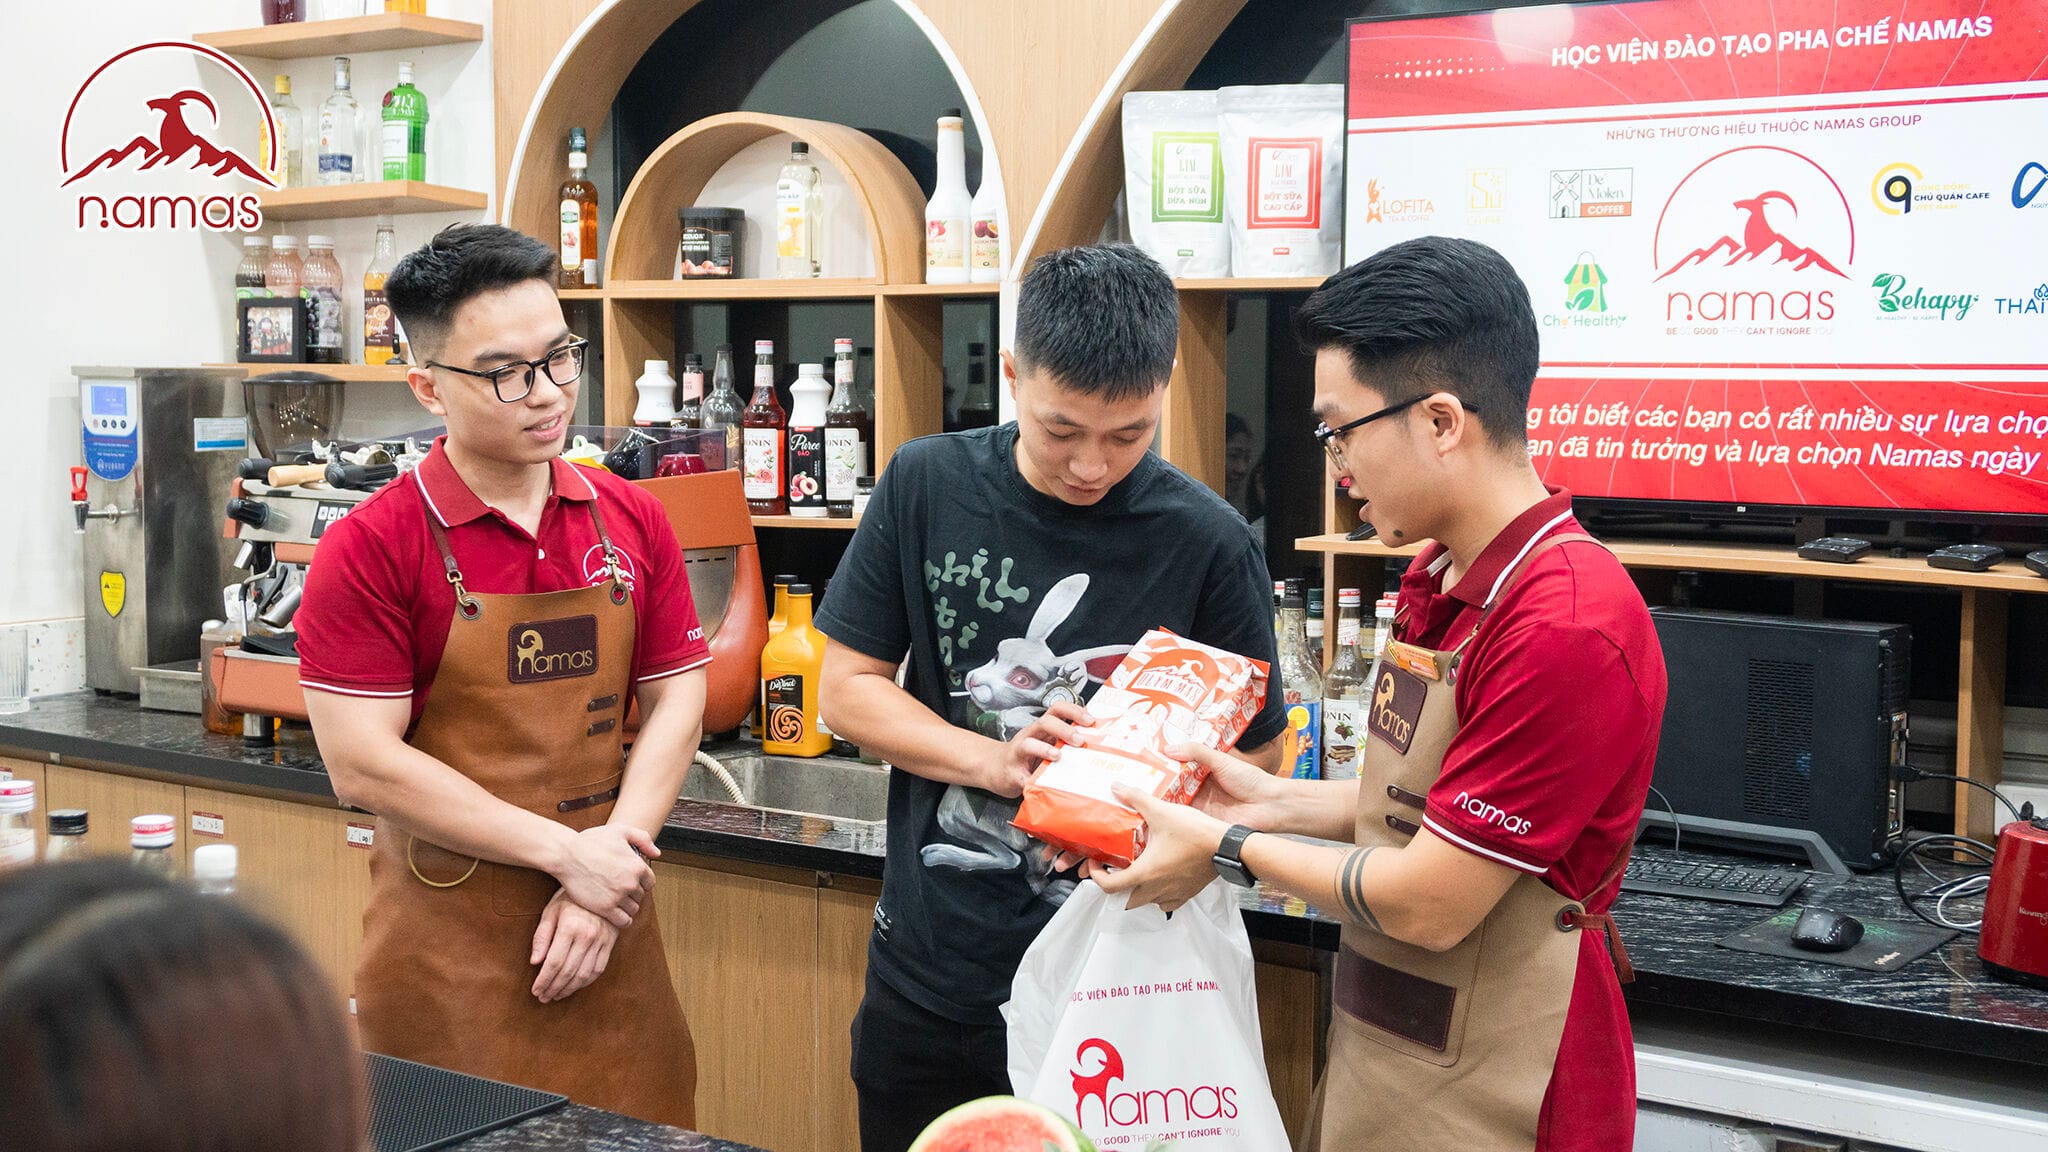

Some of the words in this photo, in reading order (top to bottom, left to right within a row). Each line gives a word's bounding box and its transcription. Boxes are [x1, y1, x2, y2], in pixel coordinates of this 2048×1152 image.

[1551, 45, 1601, 69] HỌC
[1606, 37, 1659, 65] VIỆN
[1664, 33, 1716, 59] ĐÀO
[1721, 33, 1772, 58] TẠO
[1778, 29, 1829, 51] PHA
[1835, 16, 1892, 47] CHẾ
[1896, 16, 1993, 43] NAMAS
[1659, 125, 1720, 138] THƯƠNG
[1724, 121, 1757, 137] HIỆU
[1761, 118, 1809, 134] THUỘC
[1813, 117, 1865, 131] NAMAS
[1869, 114, 1922, 128] GROUP
[1965, 191, 1991, 200] CAFE
[1382, 198, 1435, 215] LOFITA
[1587, 204, 1625, 216] COFFEE
[1666, 290, 1835, 321] namas
[1693, 327, 1719, 335] GOOD
[1549, 403, 1578, 425] tôi
[1583, 401, 1630, 426] biết
[1635, 404, 1678, 428] các
[1684, 405, 1732, 433] bạn
[1739, 406, 1771, 429] có
[1777, 404, 1814, 431] rất
[1820, 405, 1894, 432] nhiều
[1899, 413, 1938, 437] sự
[1944, 409, 1989, 438] lựa
[1559, 435, 1589, 458] đã
[1596, 436, 1625, 458] tin
[1631, 436, 1708, 466] tưởng
[1714, 439, 1741, 463] và
[1748, 440, 1790, 467] lựa
[1797, 440, 1862, 469] chọn
[1869, 442, 1964, 468] Namas
[1971, 446, 2041, 475] ngày
[1453, 791, 1532, 835] namas
[1154, 982, 1173, 994] PHA
[1103, 1135, 1131, 1146] GOOD
[1158, 1130, 1186, 1142] CAN'T
[1187, 1127, 1223, 1139] IGNORE
